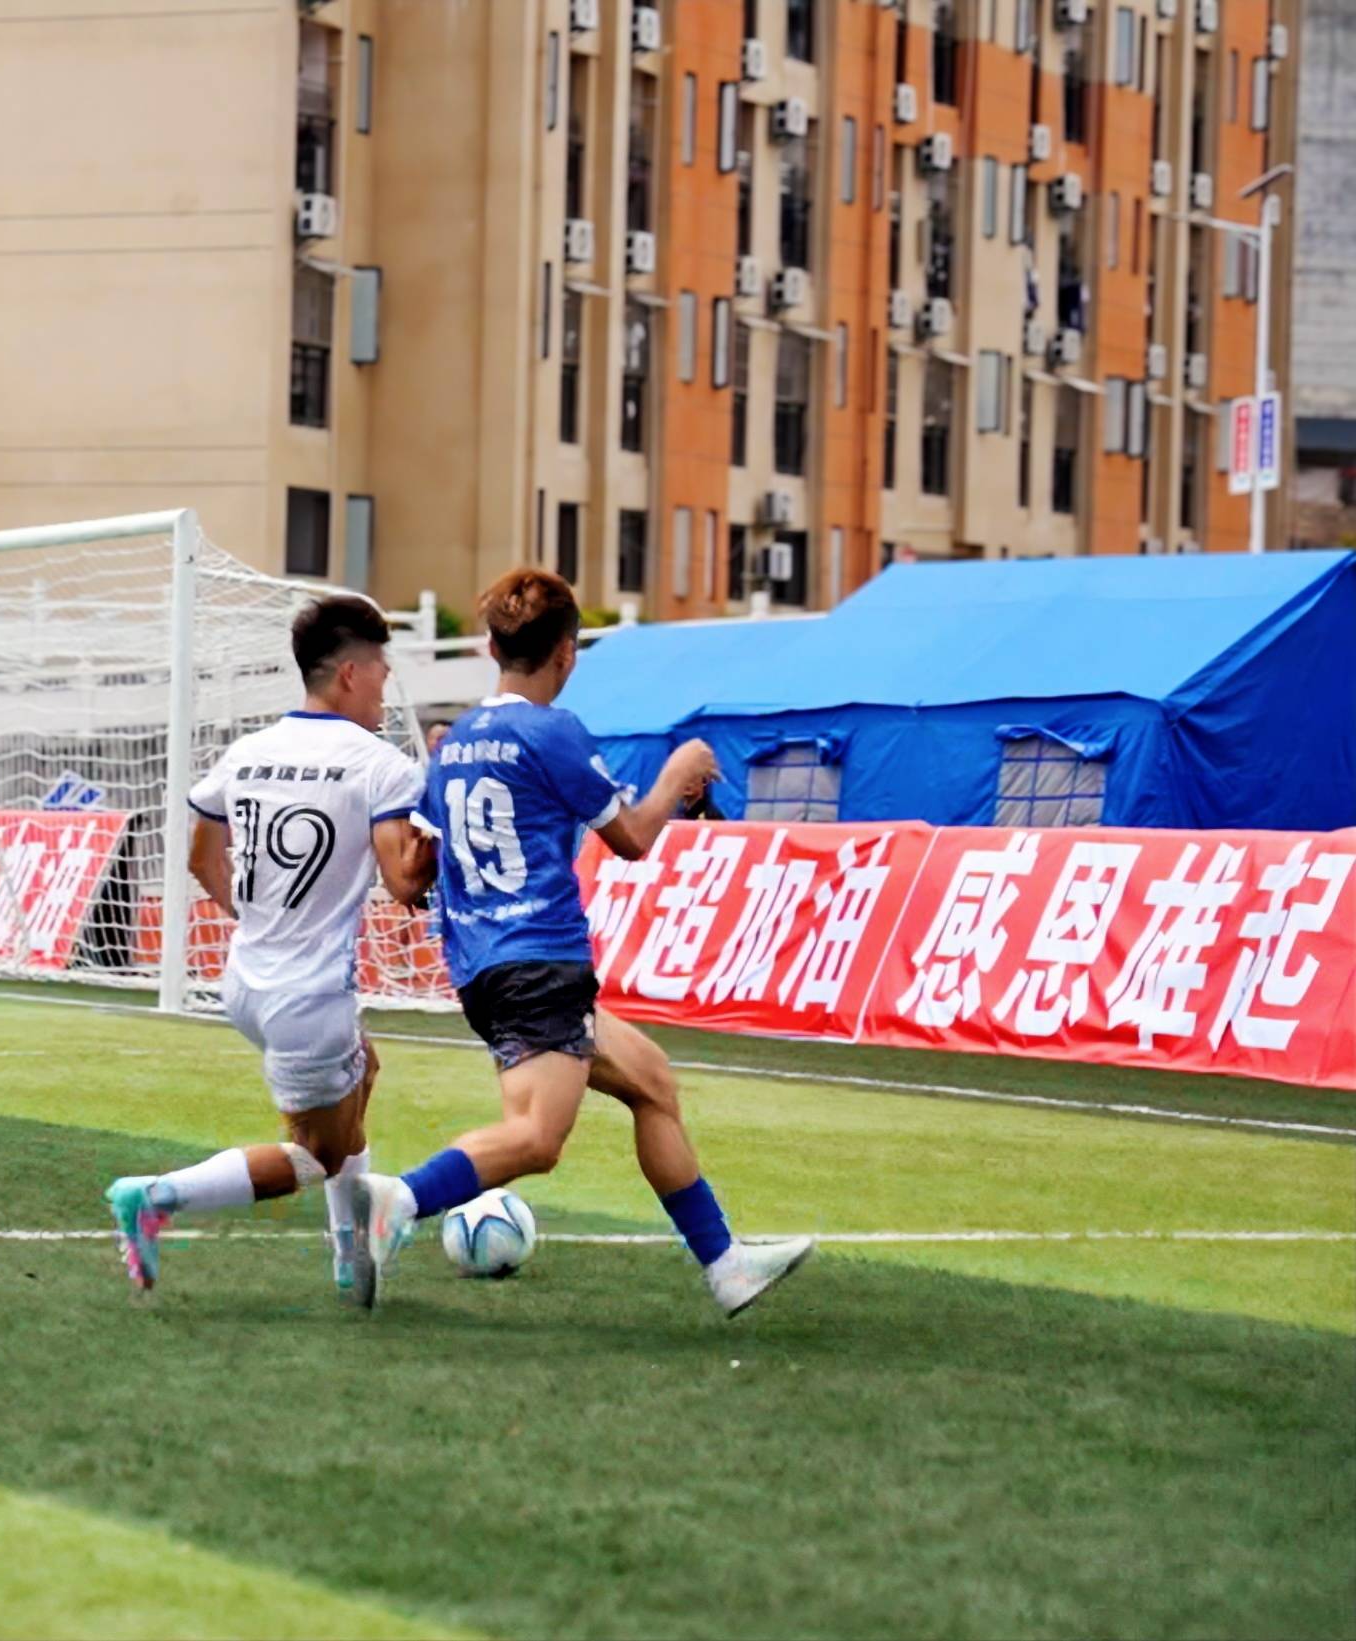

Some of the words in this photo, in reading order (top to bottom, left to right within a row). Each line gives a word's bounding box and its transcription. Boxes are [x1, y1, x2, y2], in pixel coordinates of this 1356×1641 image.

[235, 798, 336, 909] 19
[445, 777, 528, 896] 19
[895, 832, 1355, 1052] 感恩雄起
